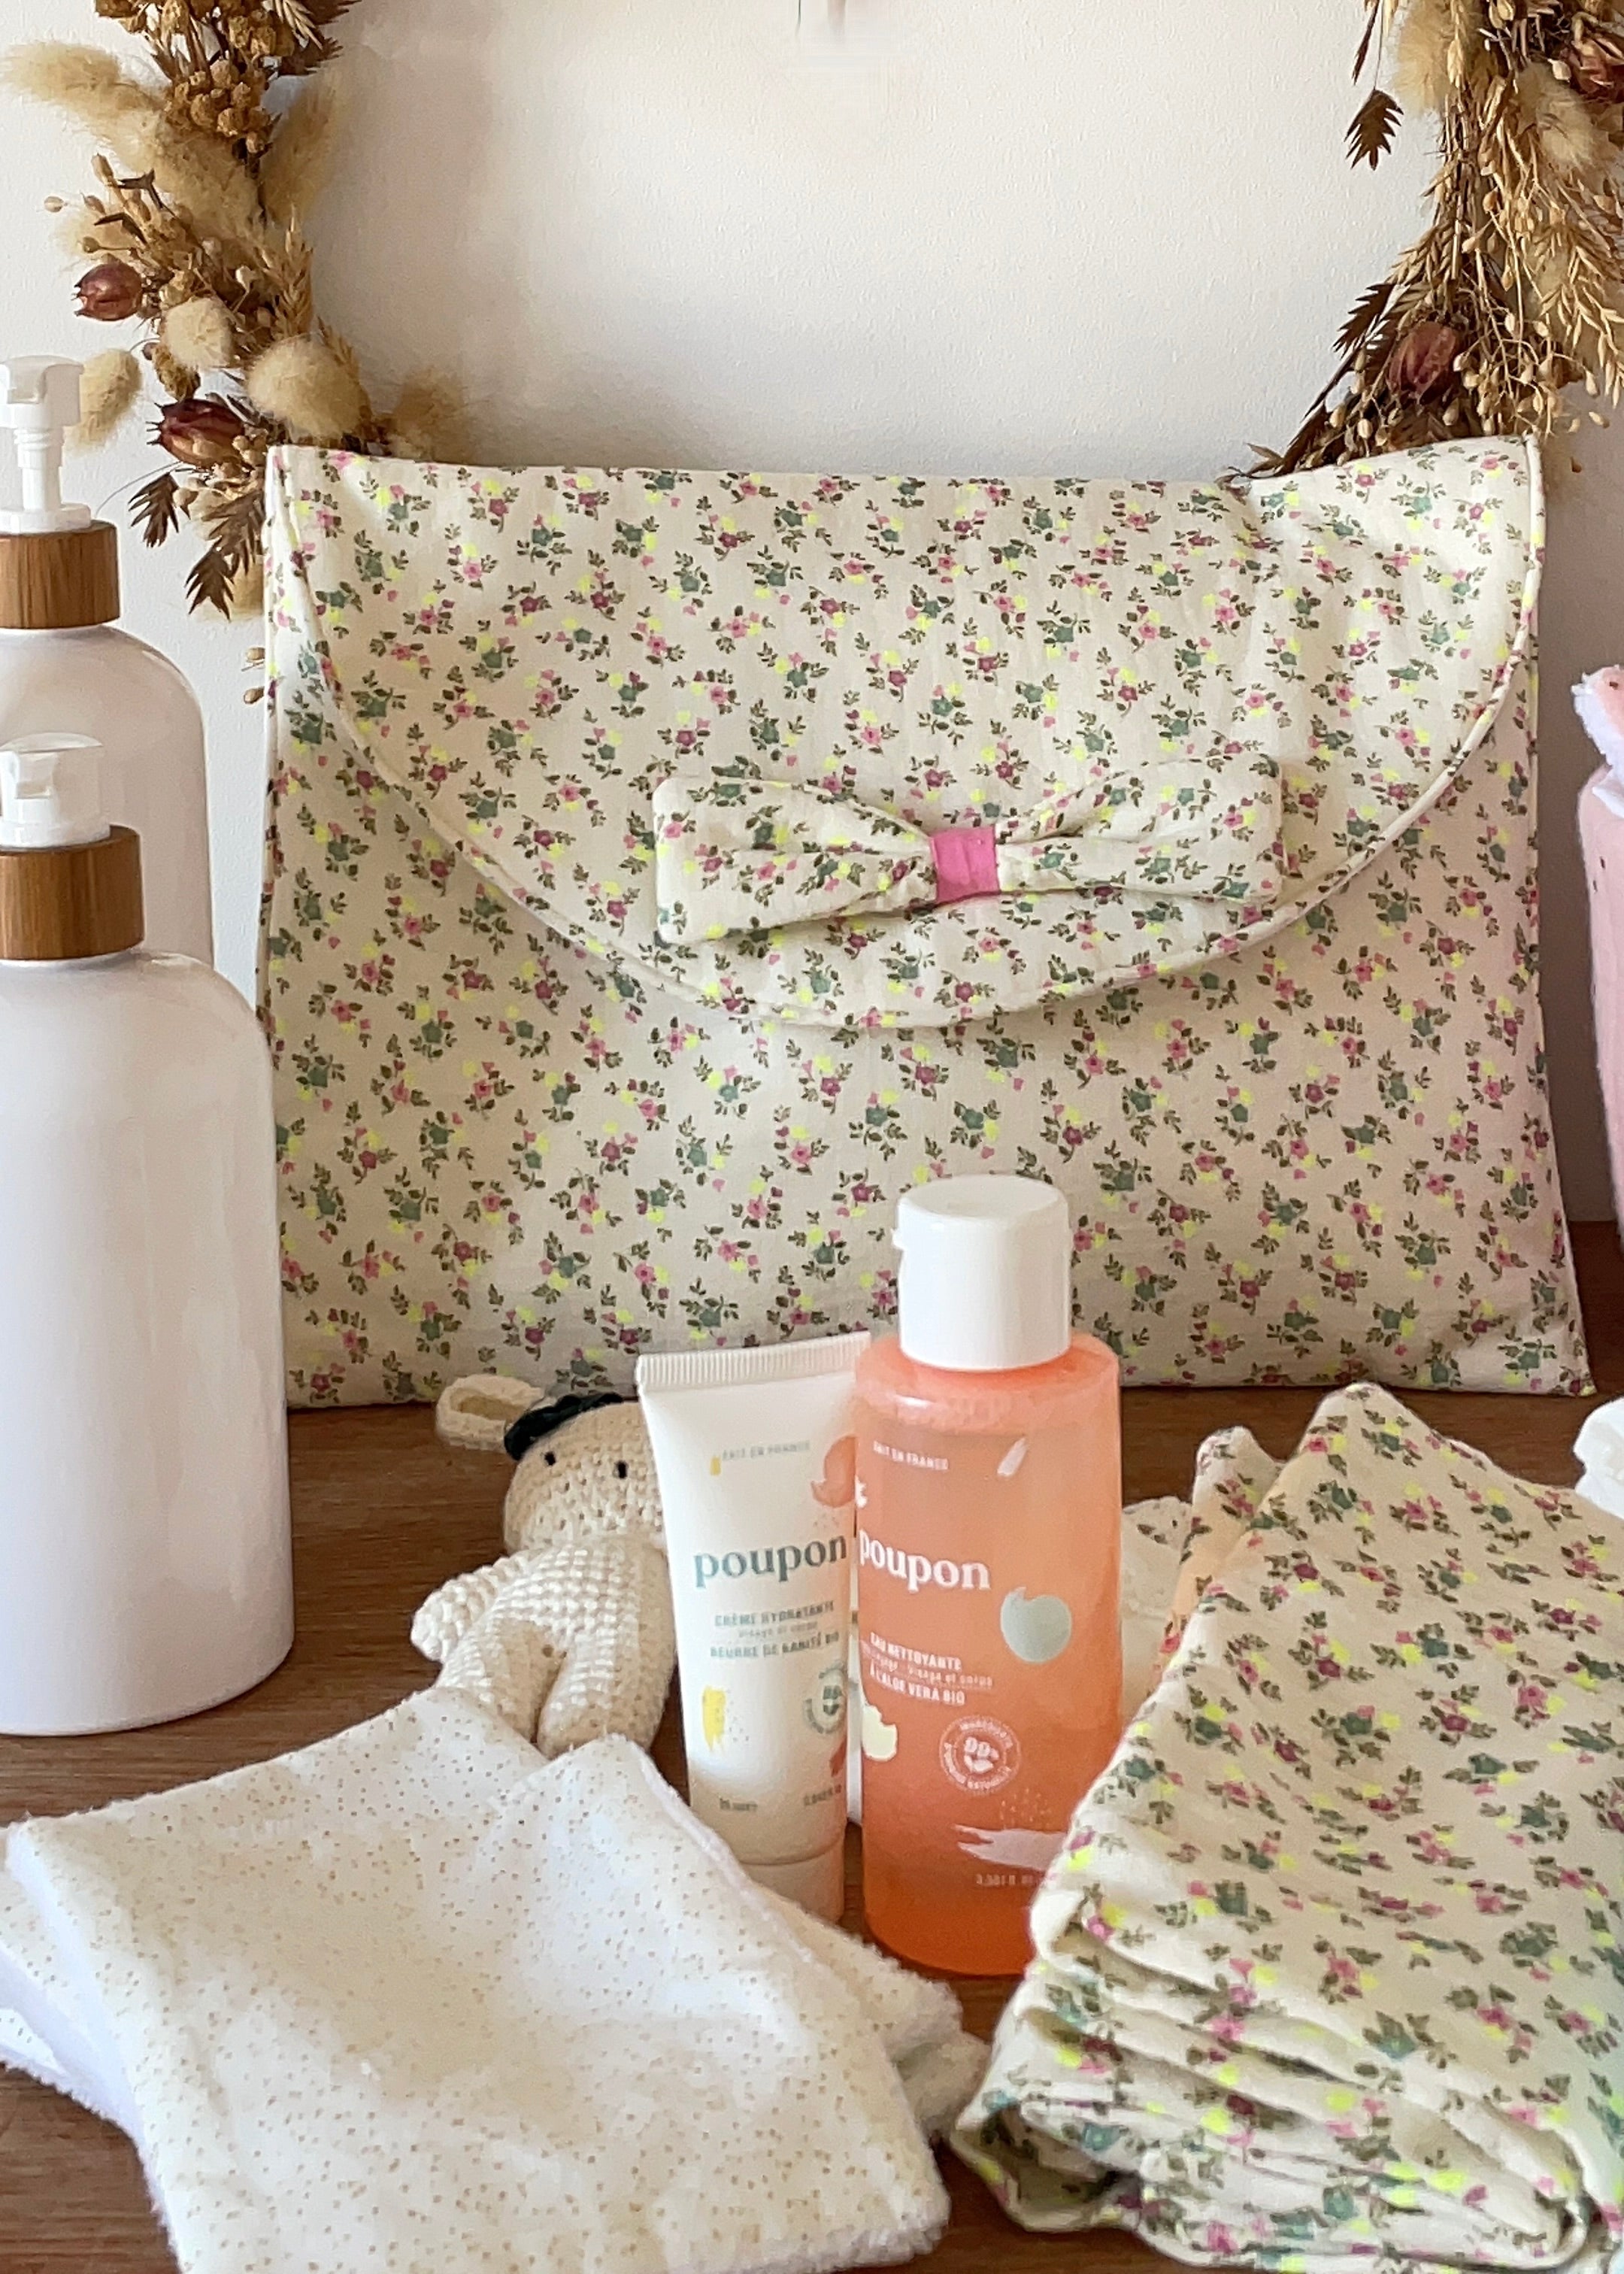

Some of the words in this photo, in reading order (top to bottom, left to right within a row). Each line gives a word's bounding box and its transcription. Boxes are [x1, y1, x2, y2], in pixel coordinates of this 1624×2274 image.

[693, 1535, 847, 1589] poupon
[859, 1528, 992, 1594] poupon
[887, 1642, 963, 1671] NETTOYANTE
[908, 1681, 940, 1702] VERA
[943, 1690, 965, 1706] BIO
